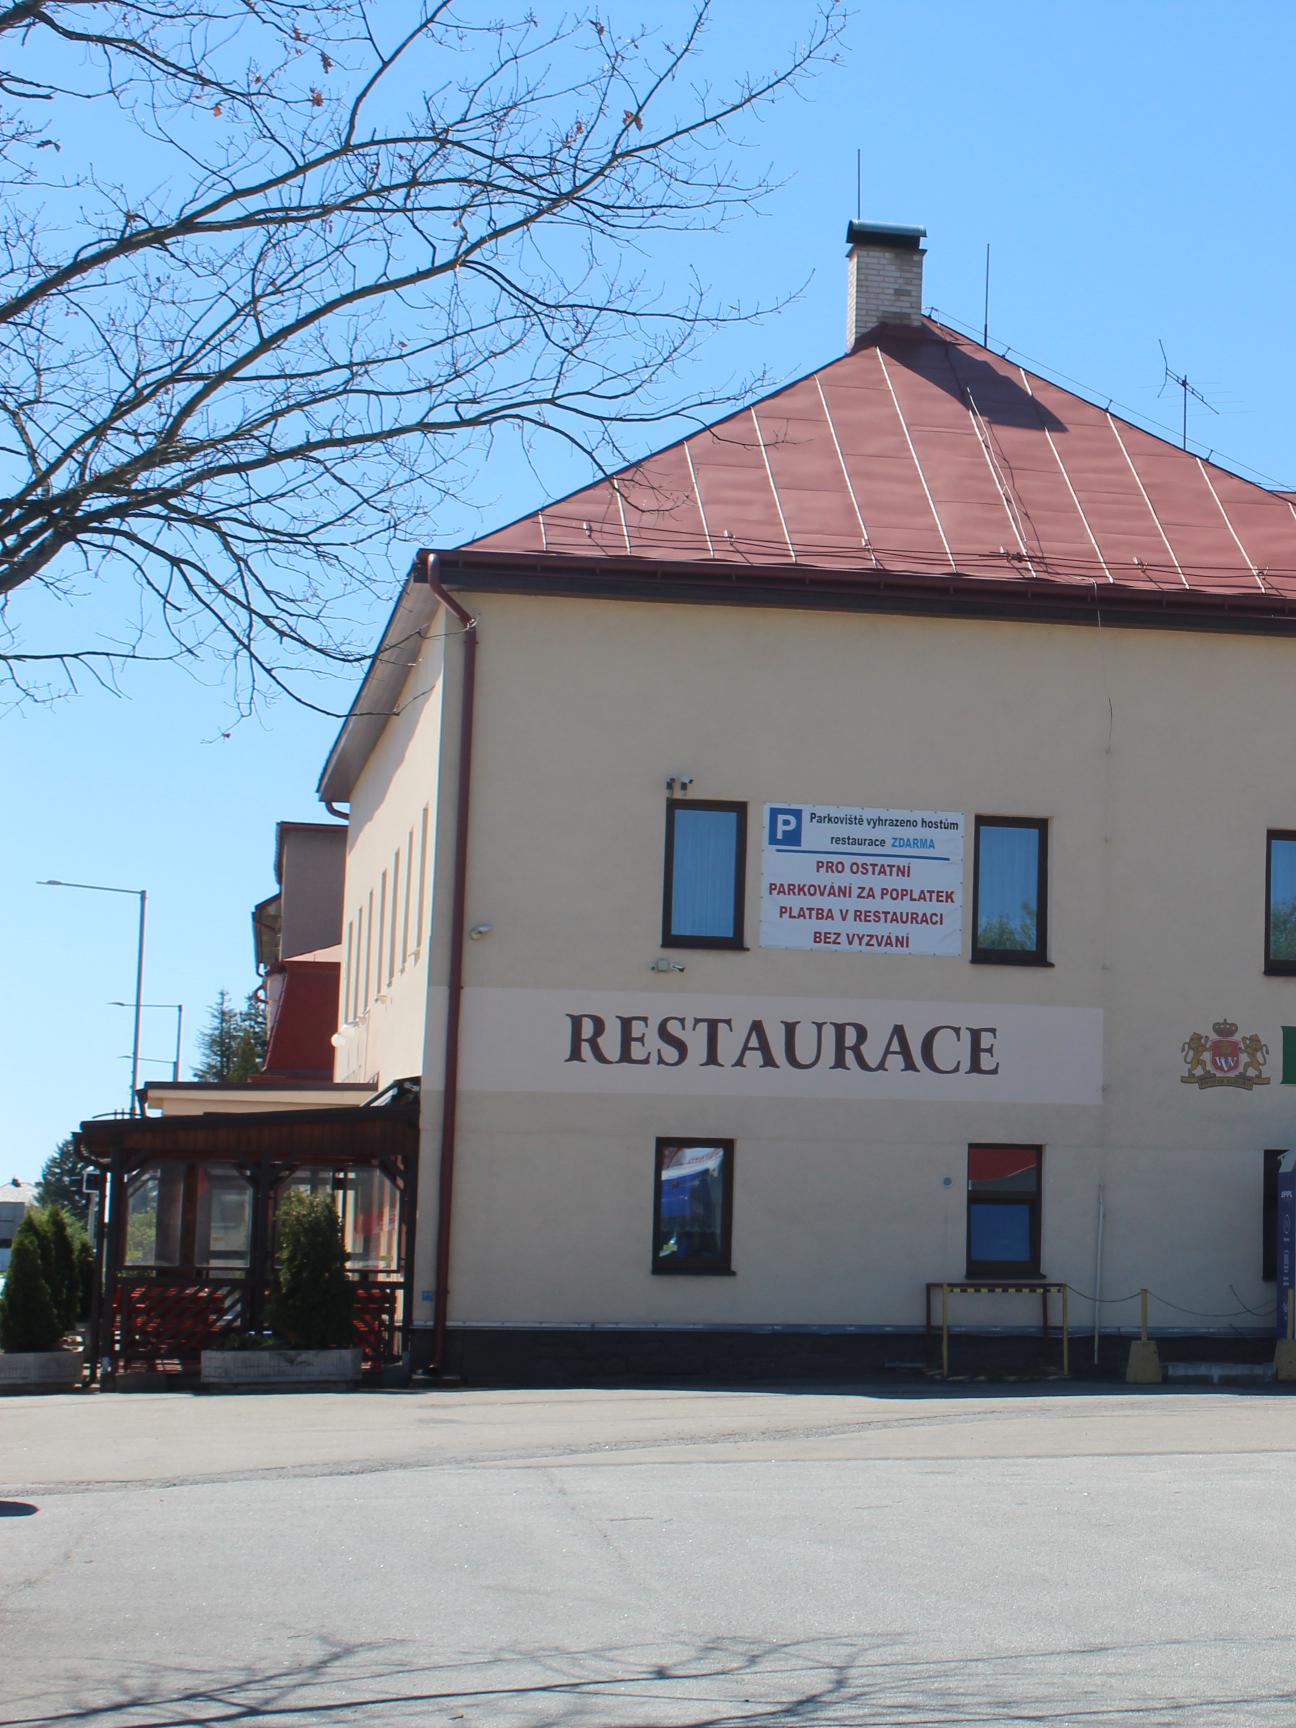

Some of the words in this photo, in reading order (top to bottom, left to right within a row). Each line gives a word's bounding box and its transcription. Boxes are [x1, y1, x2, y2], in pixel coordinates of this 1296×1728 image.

[776, 814, 797, 839] P
[810, 812, 864, 826] Parkoviště
[866, 816, 918, 828] vyhrazeno
[921, 817, 959, 831] hostům
[830, 835, 886, 848] restaurace
[891, 837, 936, 850] ZDARMA
[816, 861, 845, 874] PRO
[850, 861, 911, 878] OSTATNÍ
[768, 881, 852, 899] PARKOVÁNÍ
[857, 886, 876, 900] ZA
[881, 888, 955, 904] POPLATEK
[779, 906, 835, 921] PLATBA
[839, 909, 849, 921] V
[853, 909, 944, 926] RESTAURACI
[813, 931, 841, 946] BEZ
[846, 932, 910, 949] VYZVÁNÍ
[564, 1013, 1001, 1076] RESTAURACE
